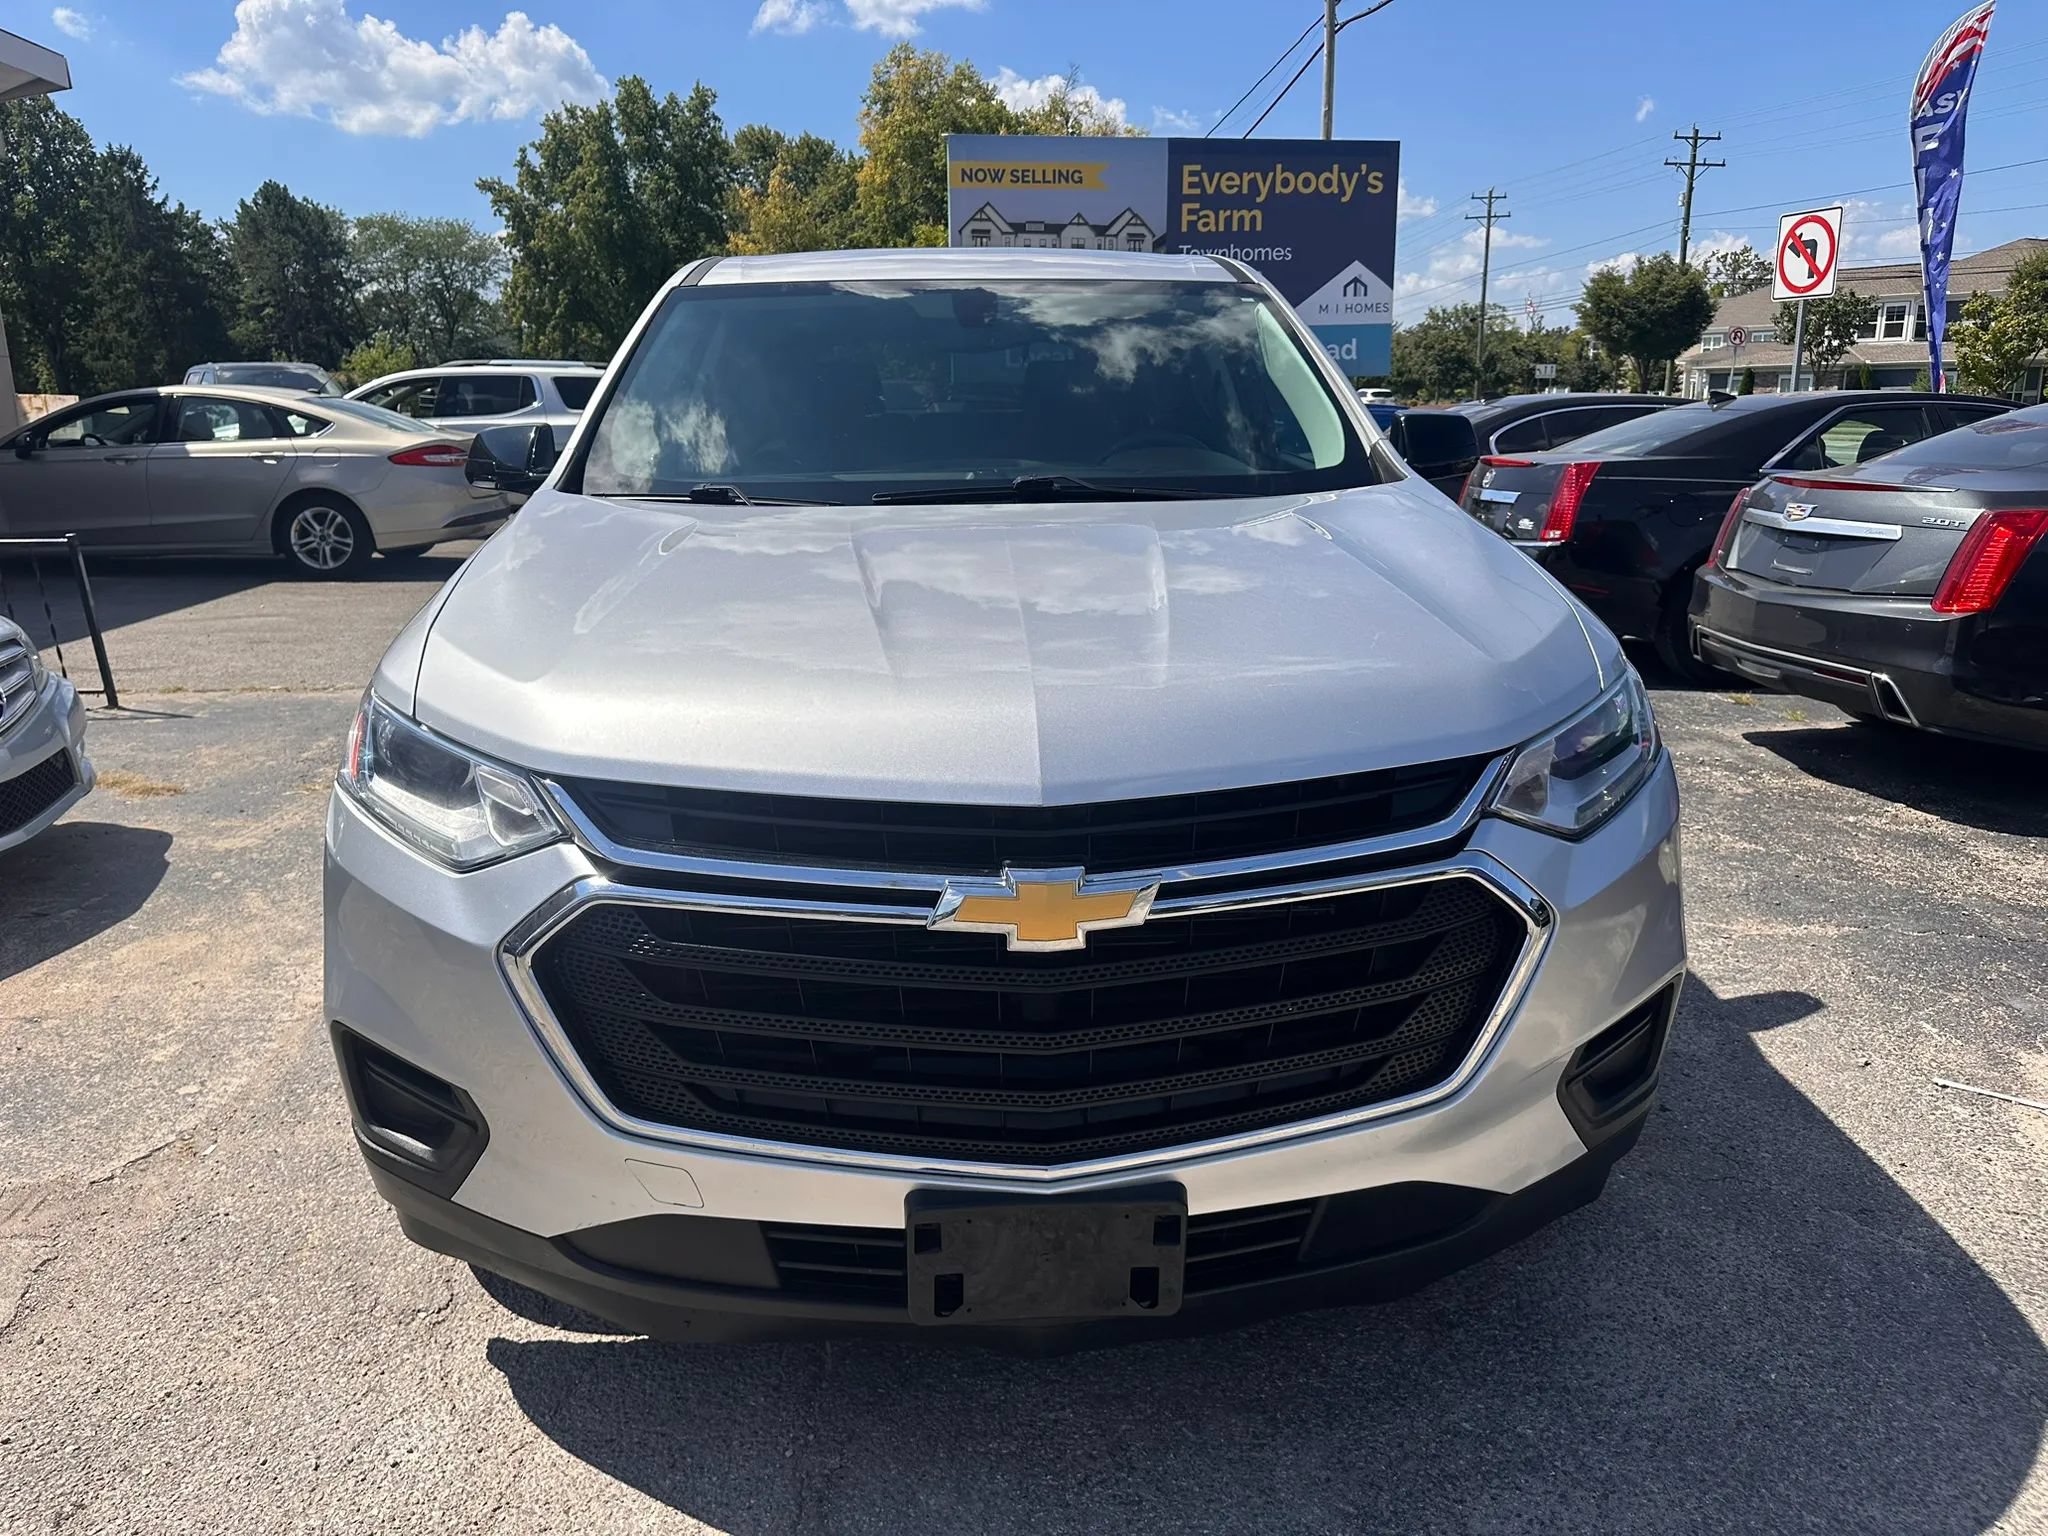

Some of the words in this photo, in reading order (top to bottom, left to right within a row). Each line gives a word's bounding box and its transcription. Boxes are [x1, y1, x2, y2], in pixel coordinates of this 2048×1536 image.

[960, 167, 1005, 184] NOW
[1009, 168, 1084, 185] SELLING
[1181, 162, 1385, 202] Everybody's
[1180, 203, 1263, 233] Farm
[1318, 303, 1329, 314] M
[1344, 302, 1390, 314] HOMES
